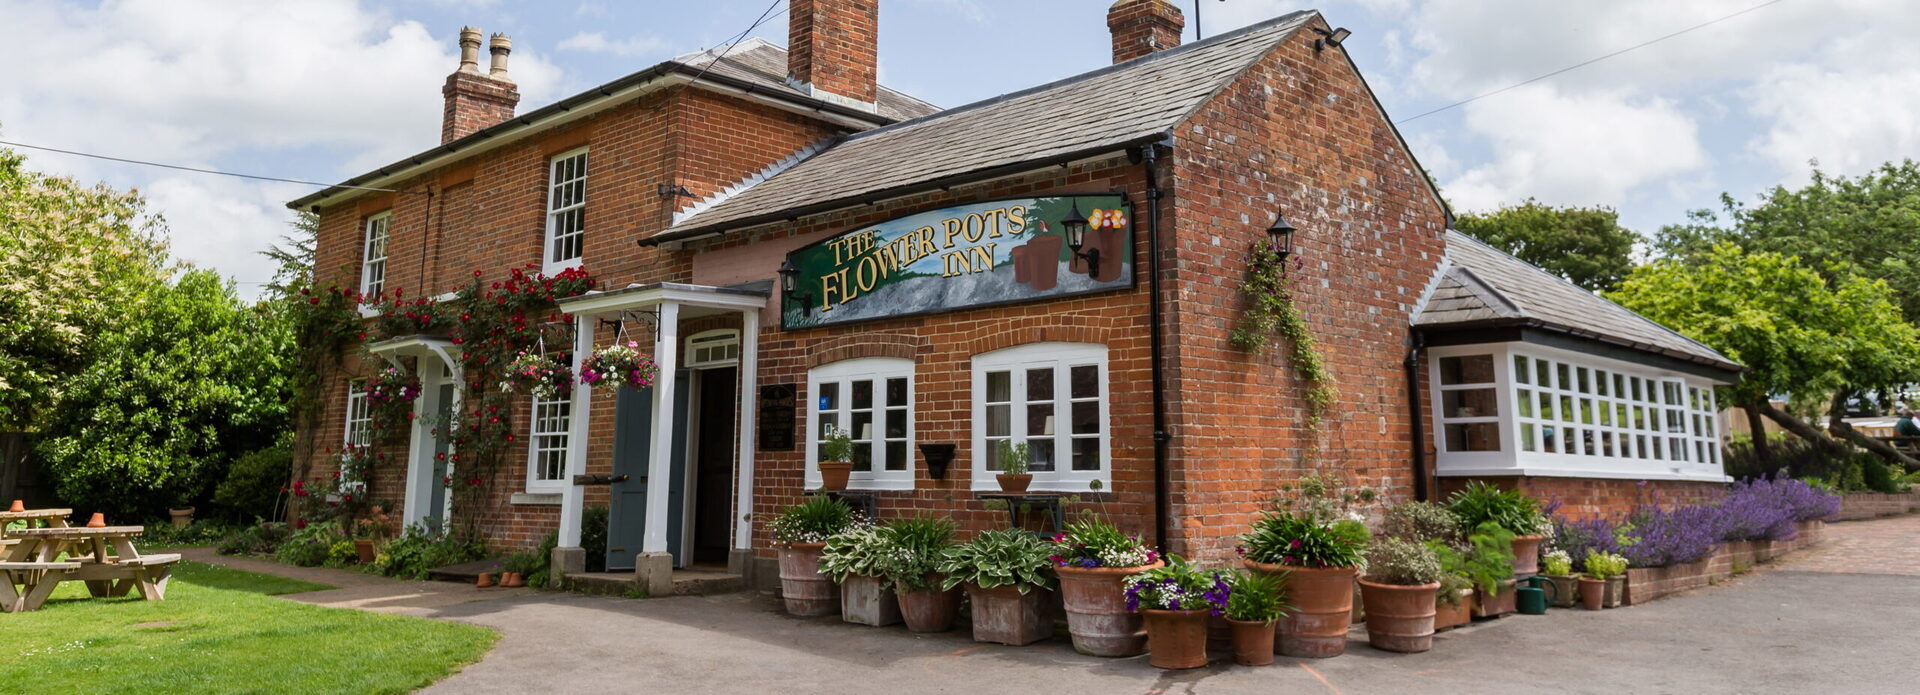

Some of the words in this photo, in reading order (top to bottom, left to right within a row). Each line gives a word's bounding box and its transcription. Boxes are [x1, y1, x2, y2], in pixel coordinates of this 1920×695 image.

[821, 225, 937, 311] FLOWER
[942, 205, 1026, 248] POTS
[829, 230, 877, 266] THE
[941, 243, 996, 278] INN
